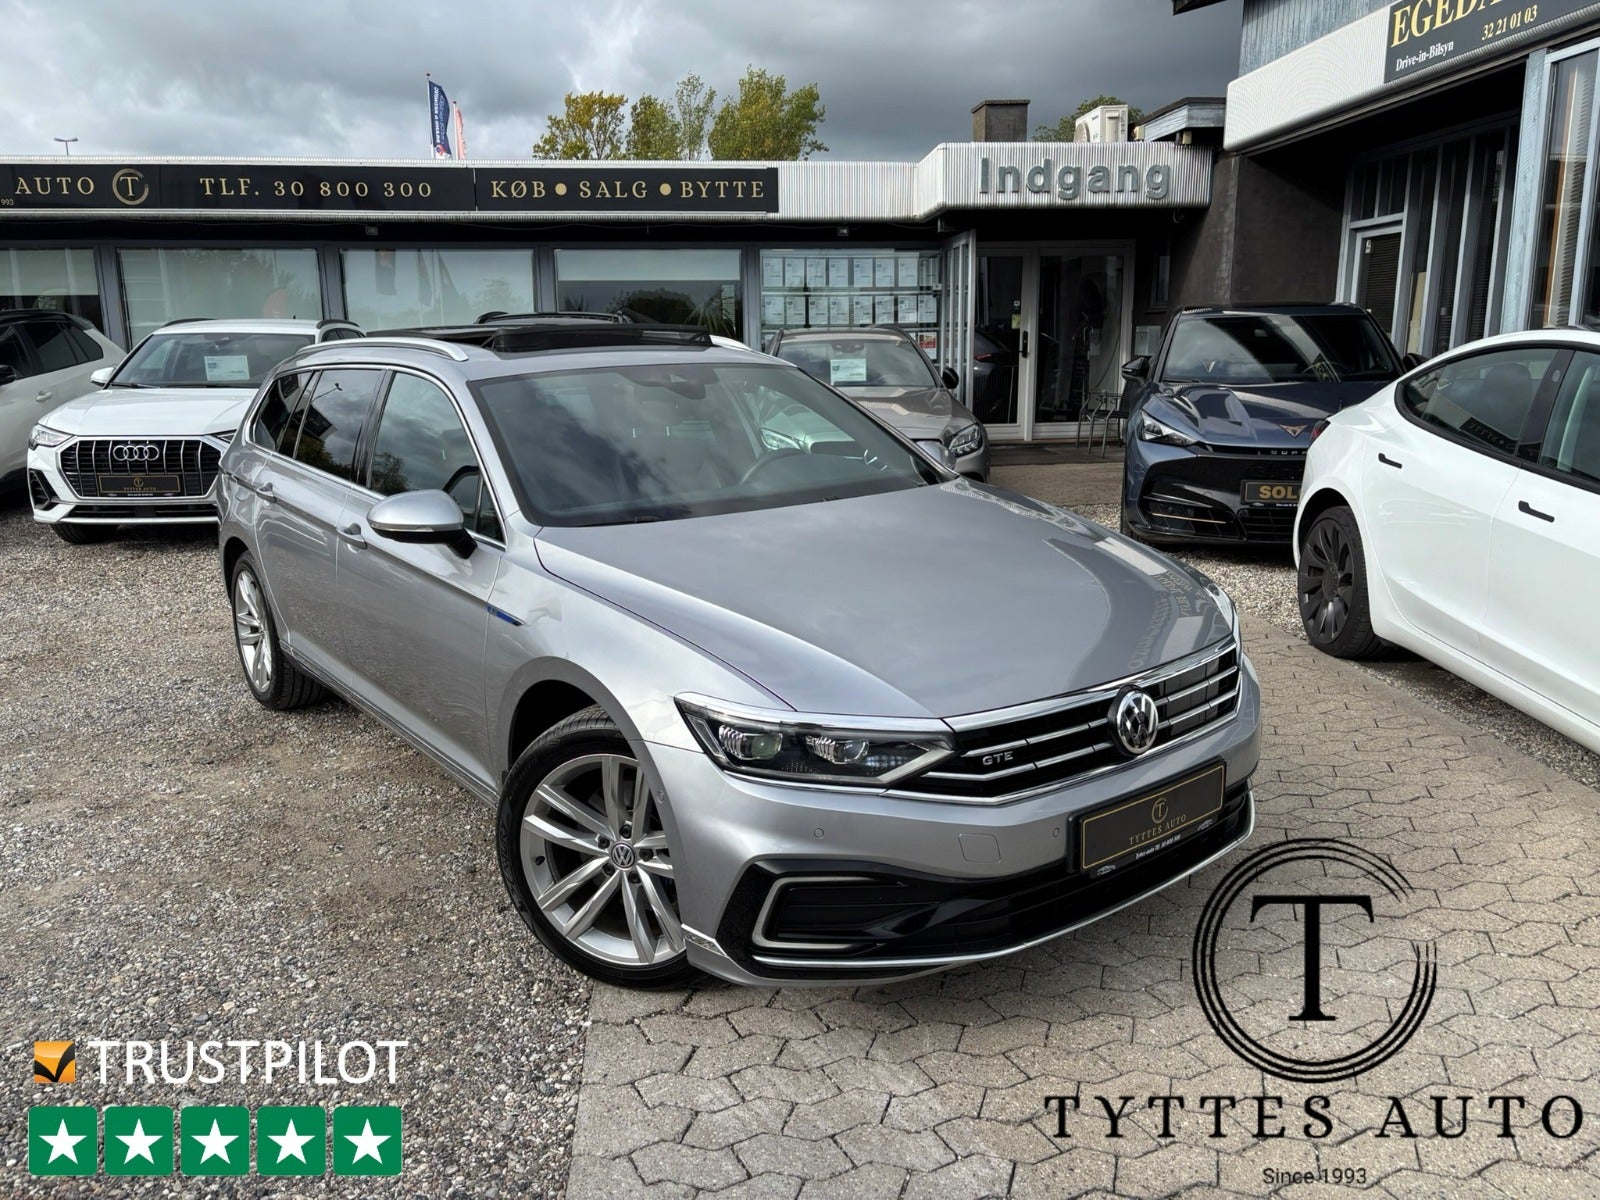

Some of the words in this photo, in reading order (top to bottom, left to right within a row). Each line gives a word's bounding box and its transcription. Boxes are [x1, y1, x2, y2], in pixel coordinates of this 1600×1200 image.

[1482, 24, 1495, 41] 32
[1495, 17, 1508, 35] 21
[1510, 11, 1522, 29] 01
[1524, 5, 1538, 24] 03
[1395, 40, 1454, 72] Drive-in-Bilsyn
[15, 177, 95, 195] AUTO
[199, 178, 260, 197] TLF.
[273, 181, 304, 197] 30
[319, 181, 369, 198] 800
[383, 182, 432, 198] 300
[979, 157, 1171, 200] Indgang
[491, 181, 546, 198] KØB
[579, 181, 647, 198] SALG
[680, 181, 764, 198] BYTTE
[1258, 485, 1301, 500] SOL
[982, 751, 1013, 766] GTE
[1129, 827, 1163, 845] TYTTES
[1165, 814, 1187, 830] AUTO
